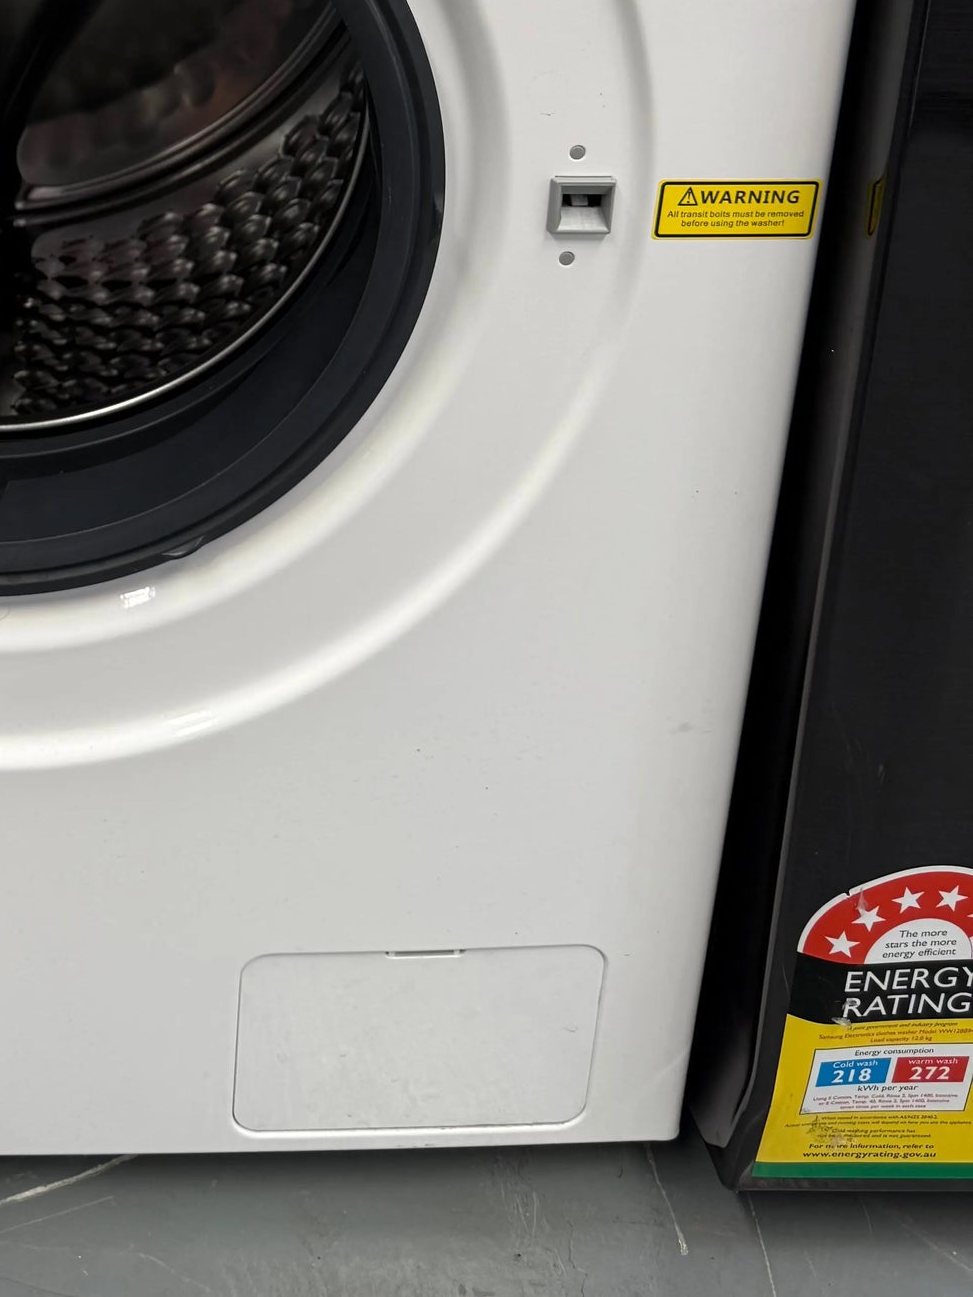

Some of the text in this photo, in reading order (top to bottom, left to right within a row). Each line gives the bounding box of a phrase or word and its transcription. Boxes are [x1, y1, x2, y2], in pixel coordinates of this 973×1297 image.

[700, 190, 801, 204] WARNING
[667, 210, 679, 218] All
[681, 210, 708, 218] transit
[709, 210, 731, 218] bolts
[755, 210, 765, 218] be
[767, 210, 805, 218] removed
[711, 220, 734, 228] using
[899, 930, 919, 938] The
[885, 940, 909, 949] stars
[911, 940, 928, 948] the
[882, 948, 957, 960] energy efficient
[844, 966, 973, 993] ENERGY
[843, 992, 973, 1018] RATING
[855, 1047, 935, 1057] Energy consumption
[833, 1060, 855, 1069] Cold
[831, 1066, 951, 1084] 218 272
[857, 1084, 919, 1093] kWh per year
